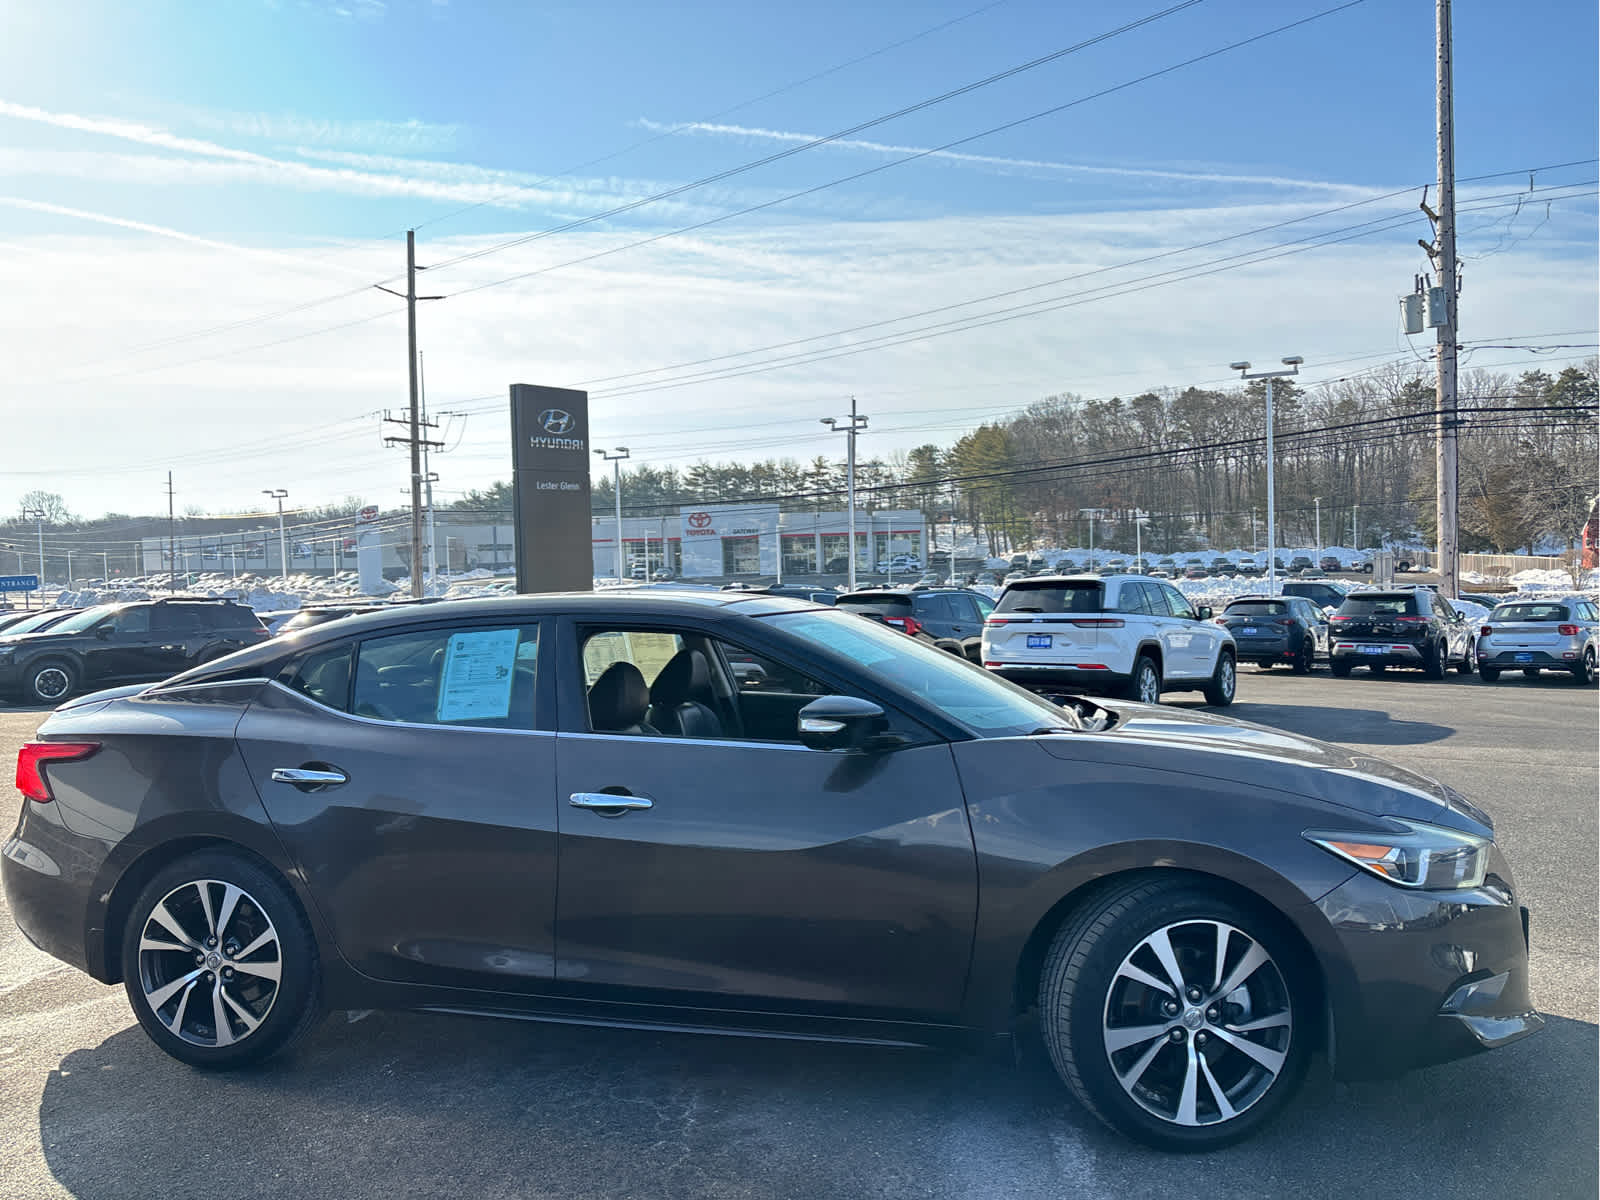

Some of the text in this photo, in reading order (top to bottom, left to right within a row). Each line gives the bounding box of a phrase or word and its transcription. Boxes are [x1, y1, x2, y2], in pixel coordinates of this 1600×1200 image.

[530, 436, 584, 450] HYUNDAI
[536, 481, 580, 490] Lester Glenn
[685, 528, 717, 536] TOYOTA
[0, 579, 36, 588] NTRANCE
